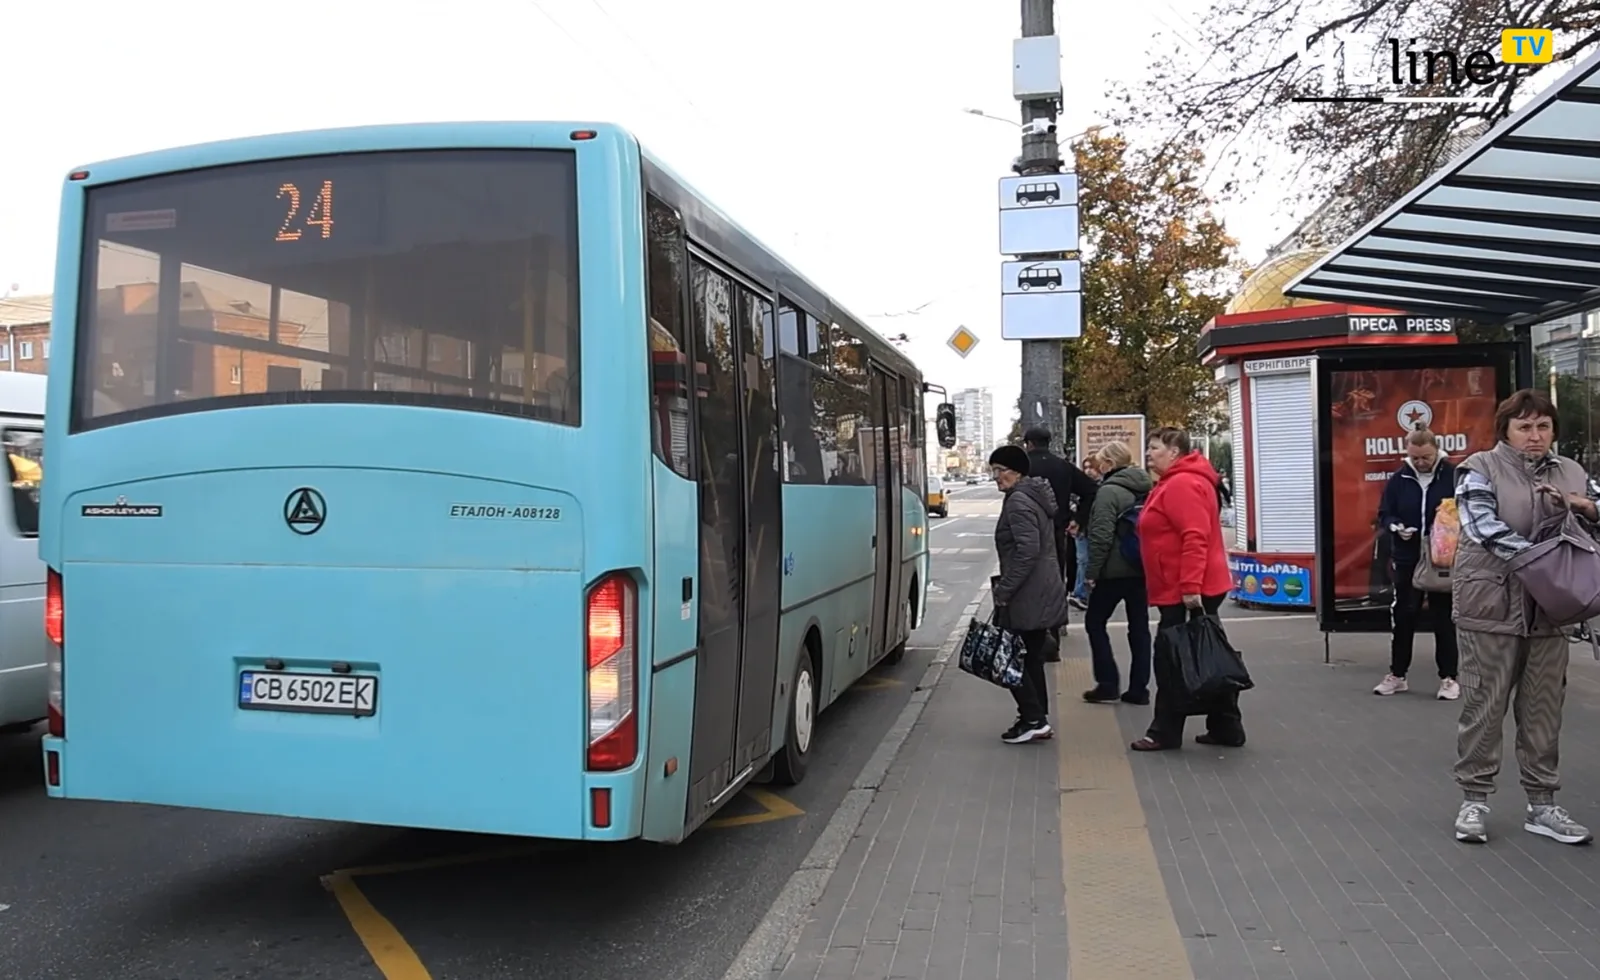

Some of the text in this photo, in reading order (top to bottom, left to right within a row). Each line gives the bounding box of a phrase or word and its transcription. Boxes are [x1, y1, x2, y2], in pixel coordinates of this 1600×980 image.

[275, 180, 334, 241] 24
[1349, 317, 1451, 331] ПРЕСА PRESS
[1365, 434, 1467, 455] HOLLOOD
[254, 678, 282, 700] CB
[286, 679, 335, 703] 6502
[339, 681, 371, 706] EK
